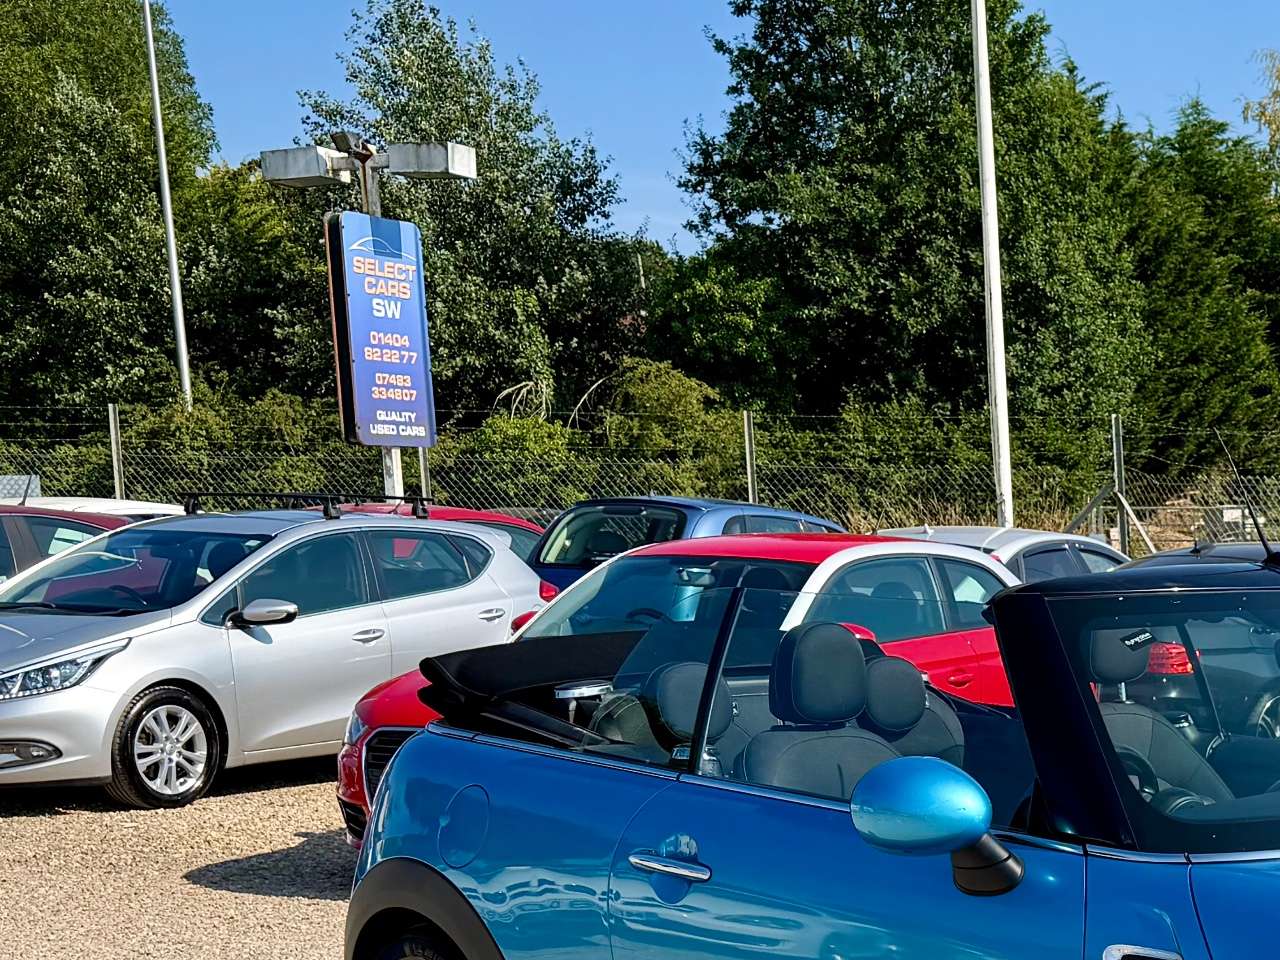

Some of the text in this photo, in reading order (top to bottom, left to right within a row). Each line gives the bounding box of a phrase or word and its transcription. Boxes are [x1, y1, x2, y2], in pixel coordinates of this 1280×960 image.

[353, 256, 416, 281] SELECT
[365, 276, 411, 300] CARS
[372, 298, 401, 320] SW
[370, 331, 410, 348] 01404
[376, 410, 416, 423] QUALITY
[370, 423, 426, 437] USED CARS
